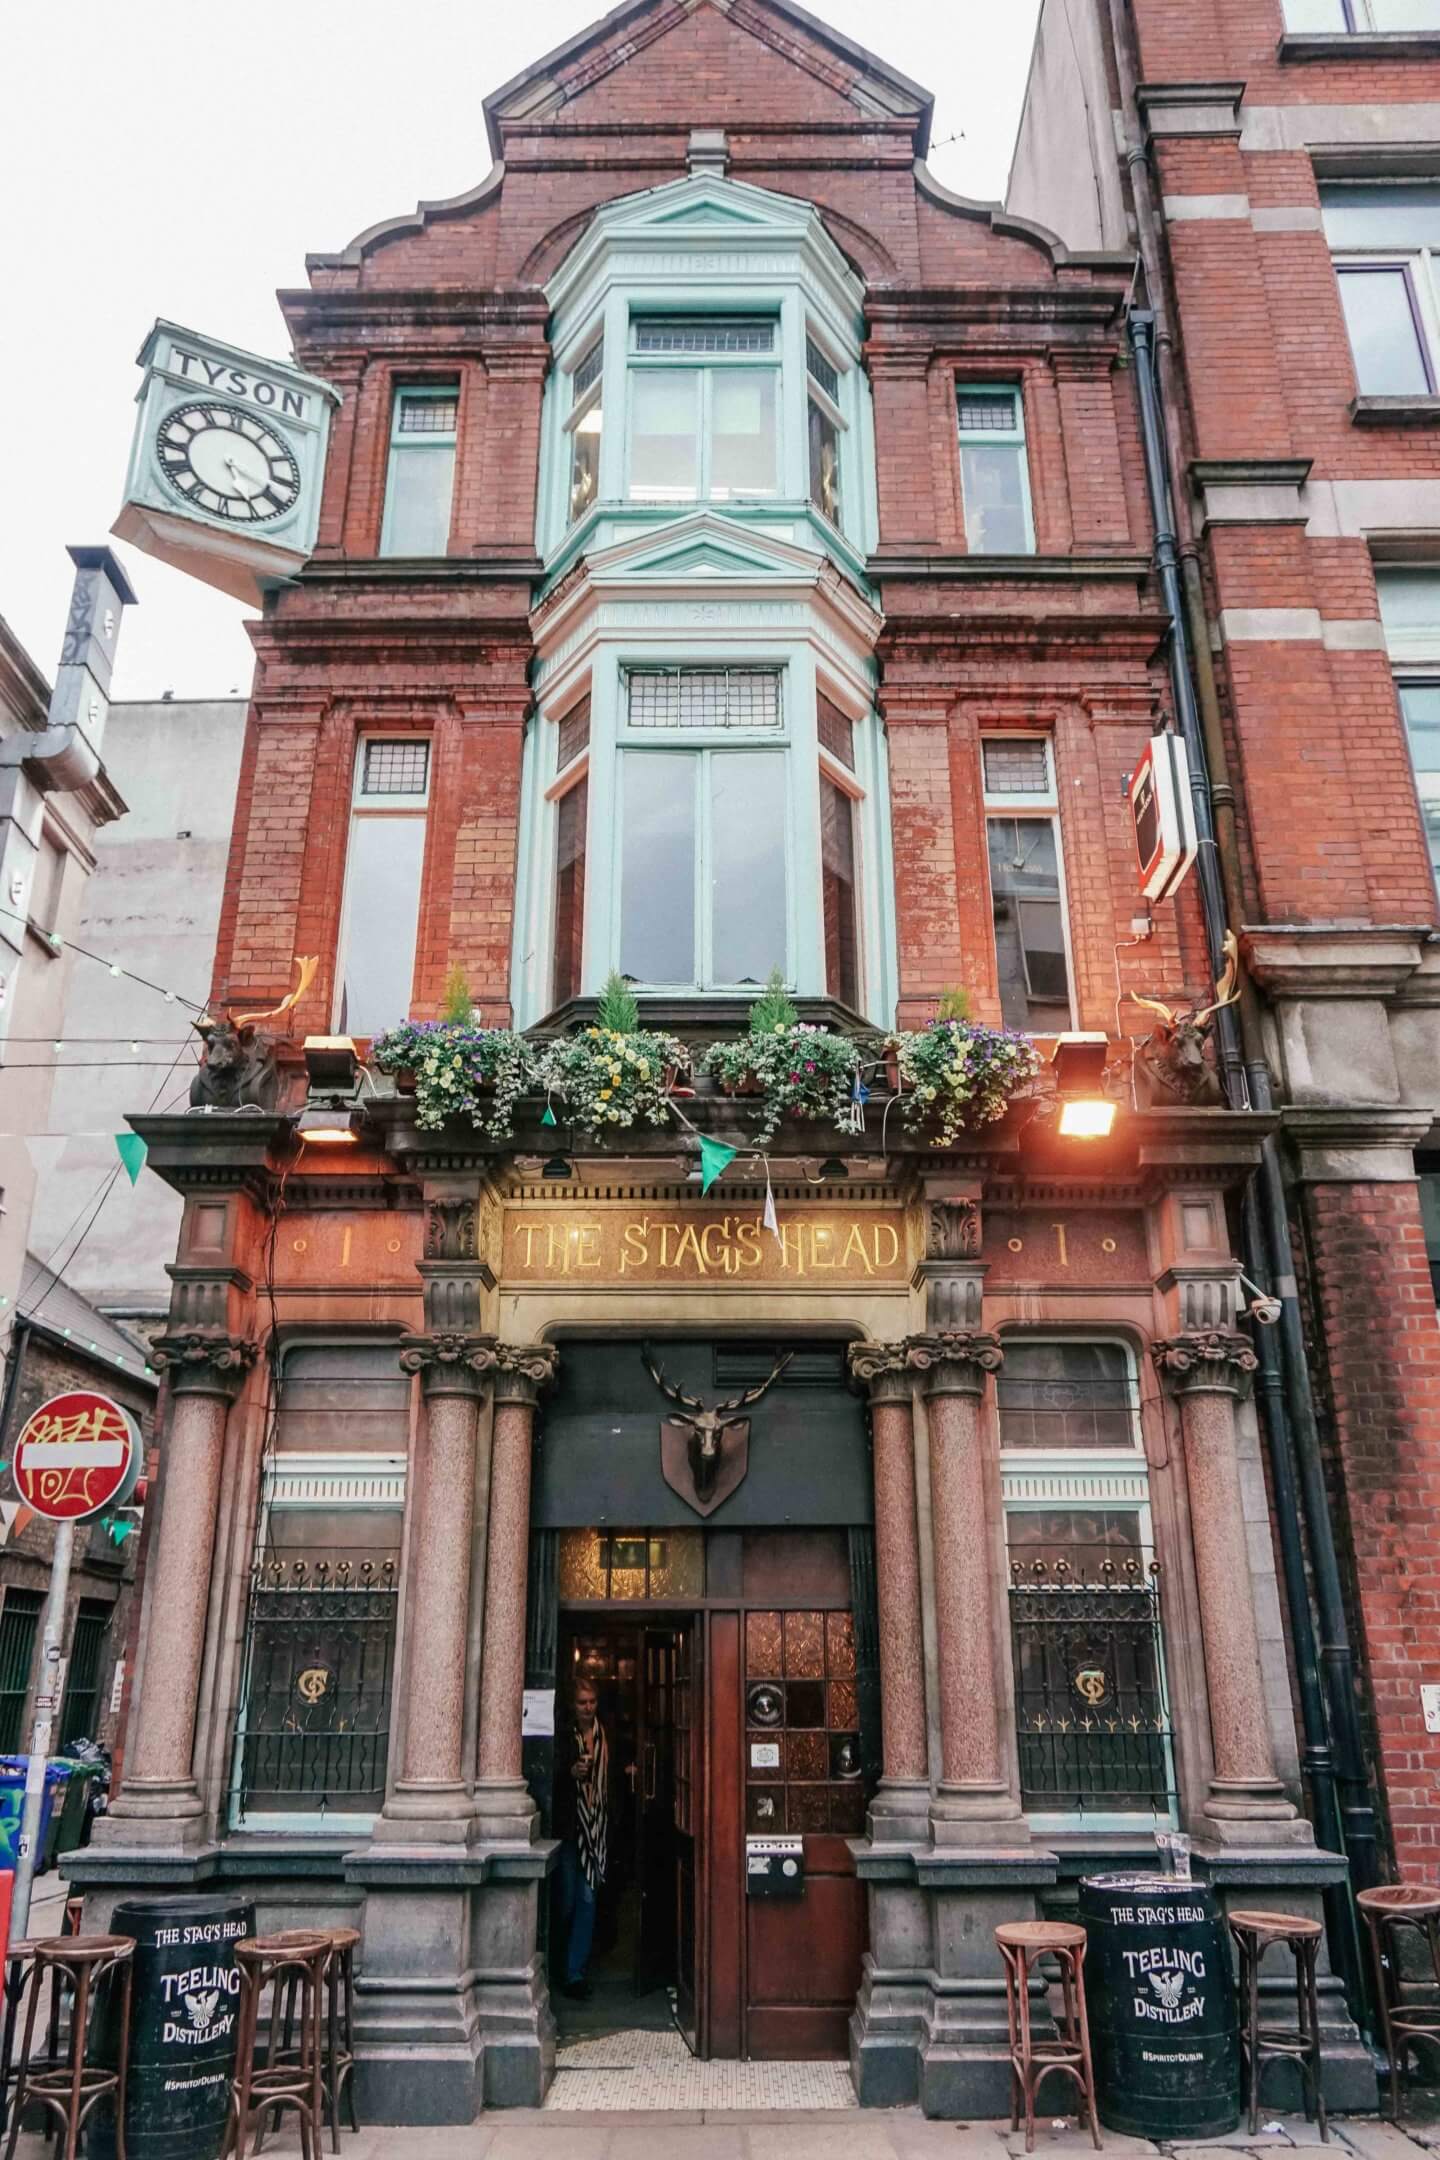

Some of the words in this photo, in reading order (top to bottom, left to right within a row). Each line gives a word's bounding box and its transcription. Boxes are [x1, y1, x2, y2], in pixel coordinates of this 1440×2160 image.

[175, 350, 304, 418] TYSON
[514, 1222, 602, 1275] THE
[617, 1215, 763, 1275] STAG'S
[779, 1222, 900, 1275] HEAD
[1110, 1907, 1134, 1926] THE
[1137, 1906, 1175, 1925] STAG'S
[1176, 1906, 1205, 1922] HEAD
[154, 1927, 180, 1949] THE
[183, 1923, 221, 1944] STAG'S
[223, 1921, 247, 1938] HEAD
[1122, 1946, 1206, 1979] TEELING
[160, 1966, 240, 2003] TEELING
[1133, 1996, 1206, 2023] DISTILLERY
[162, 2013, 235, 2045] DISTILLERY
